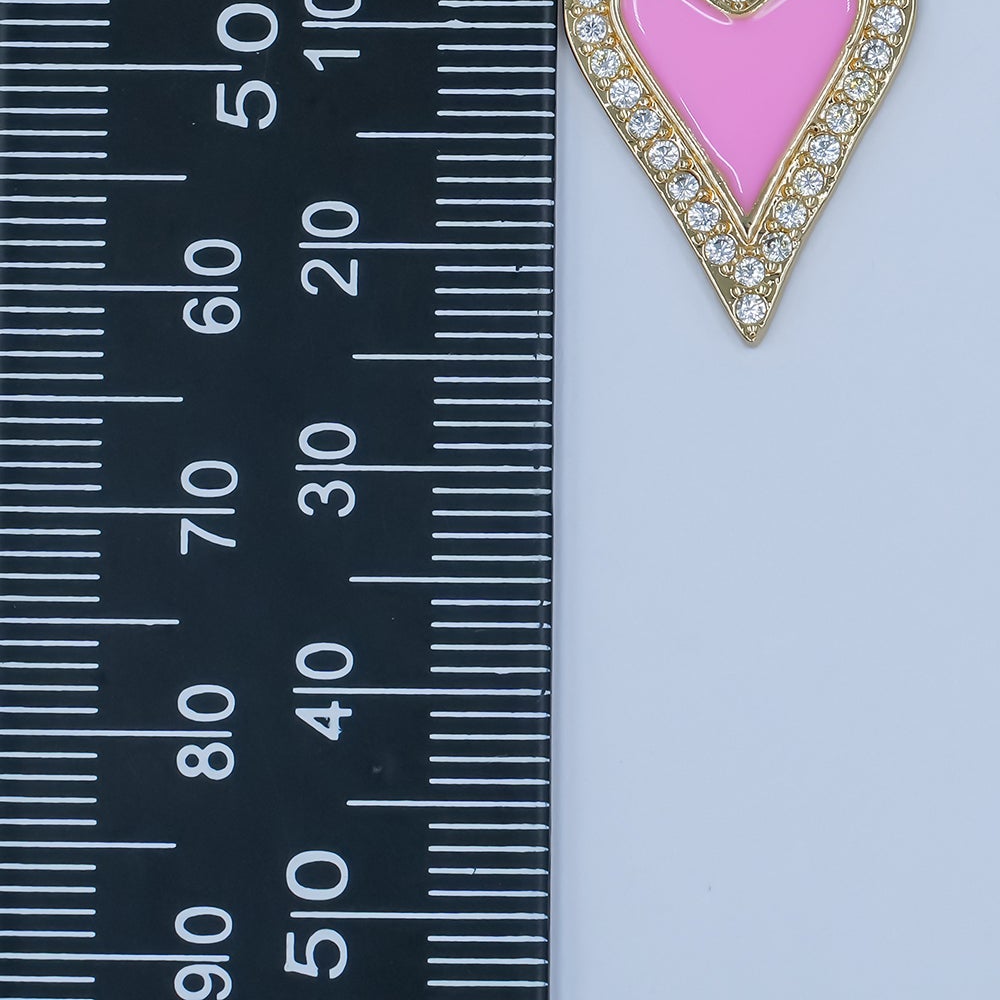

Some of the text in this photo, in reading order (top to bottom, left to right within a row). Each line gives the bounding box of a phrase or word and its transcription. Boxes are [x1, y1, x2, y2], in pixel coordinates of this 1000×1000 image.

[216, 3, 278, 130] 50
[183, 239, 241, 335] 60
[301, 200, 359, 297] 20
[181, 460, 238, 555] 70
[298, 422, 356, 518] 30
[177, 684, 235, 780] 80
[295, 642, 353, 741] 40
[174, 906, 232, 1000] 90
[284, 850, 349, 980] 50
